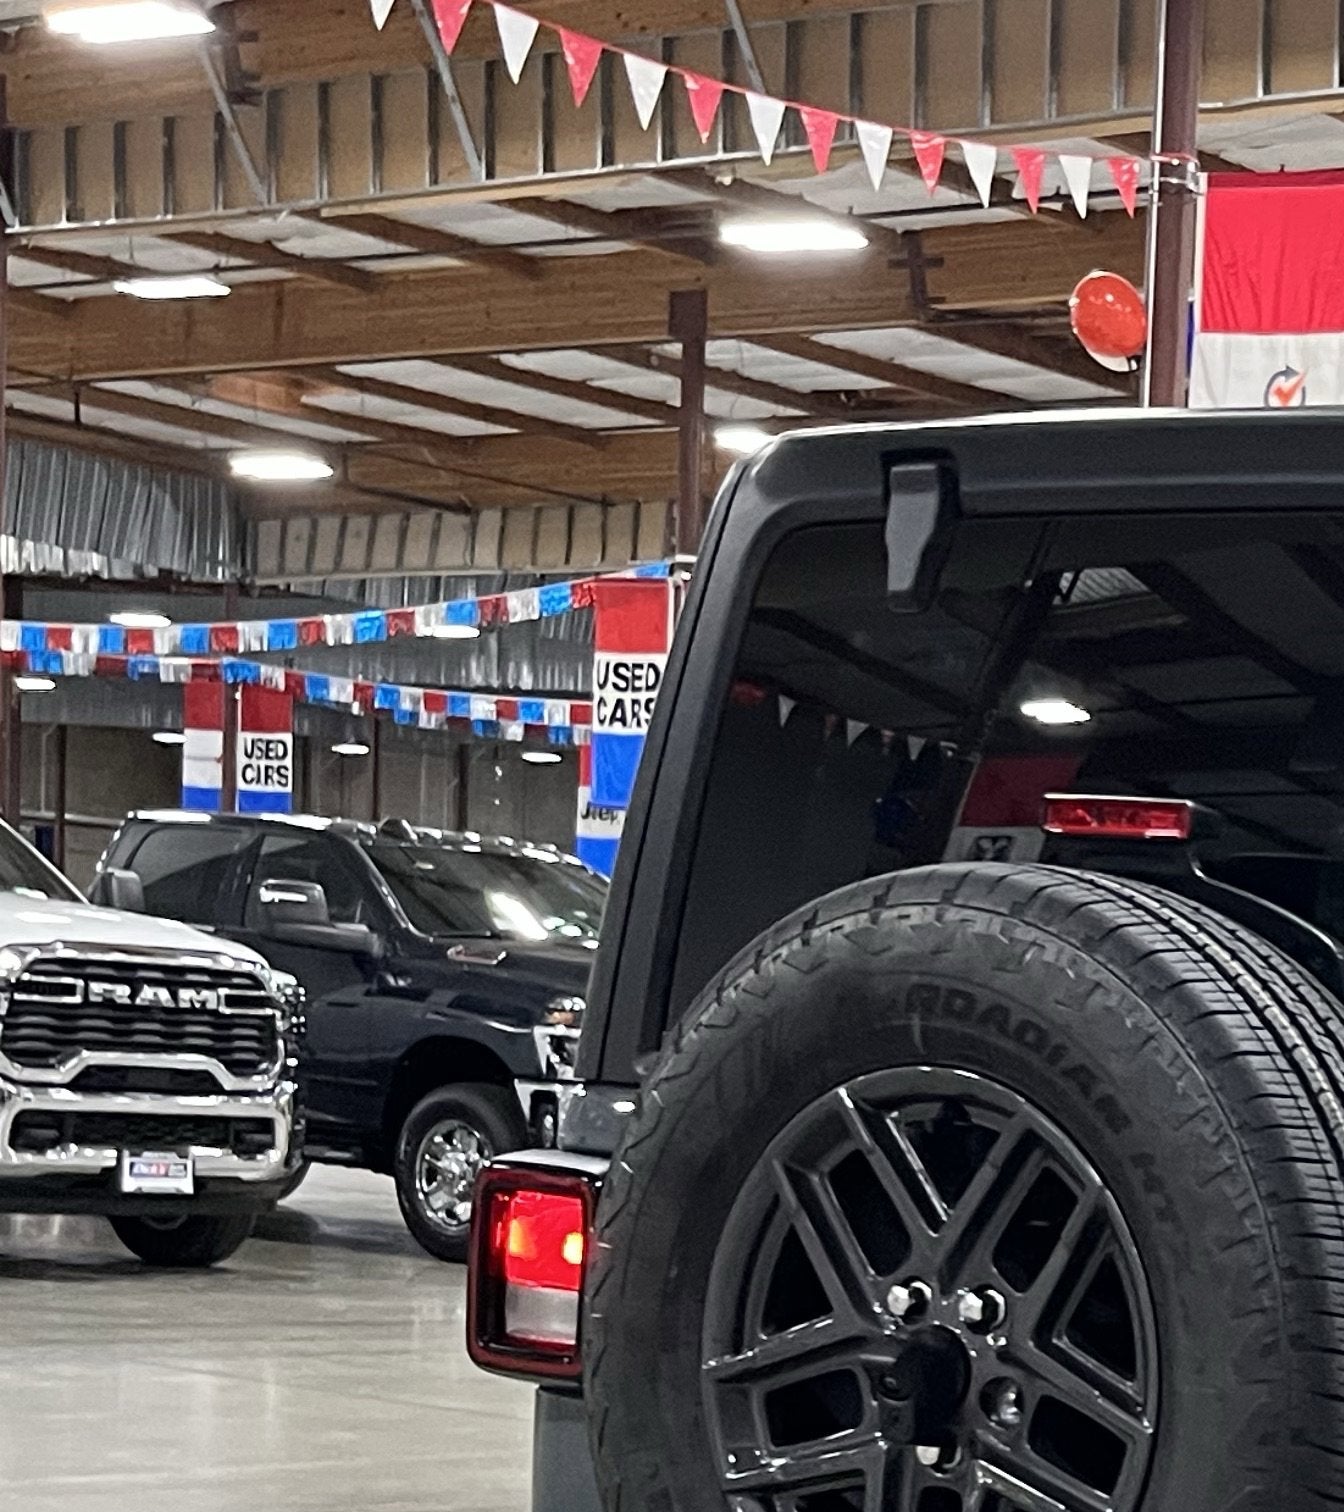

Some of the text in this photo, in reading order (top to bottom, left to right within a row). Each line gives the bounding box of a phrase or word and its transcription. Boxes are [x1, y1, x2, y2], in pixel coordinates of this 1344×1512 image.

[597, 661, 661, 692] USED
[597, 696, 656, 728] CARS
[243, 738, 289, 761] USED
[87, 981, 218, 1010] RAM
